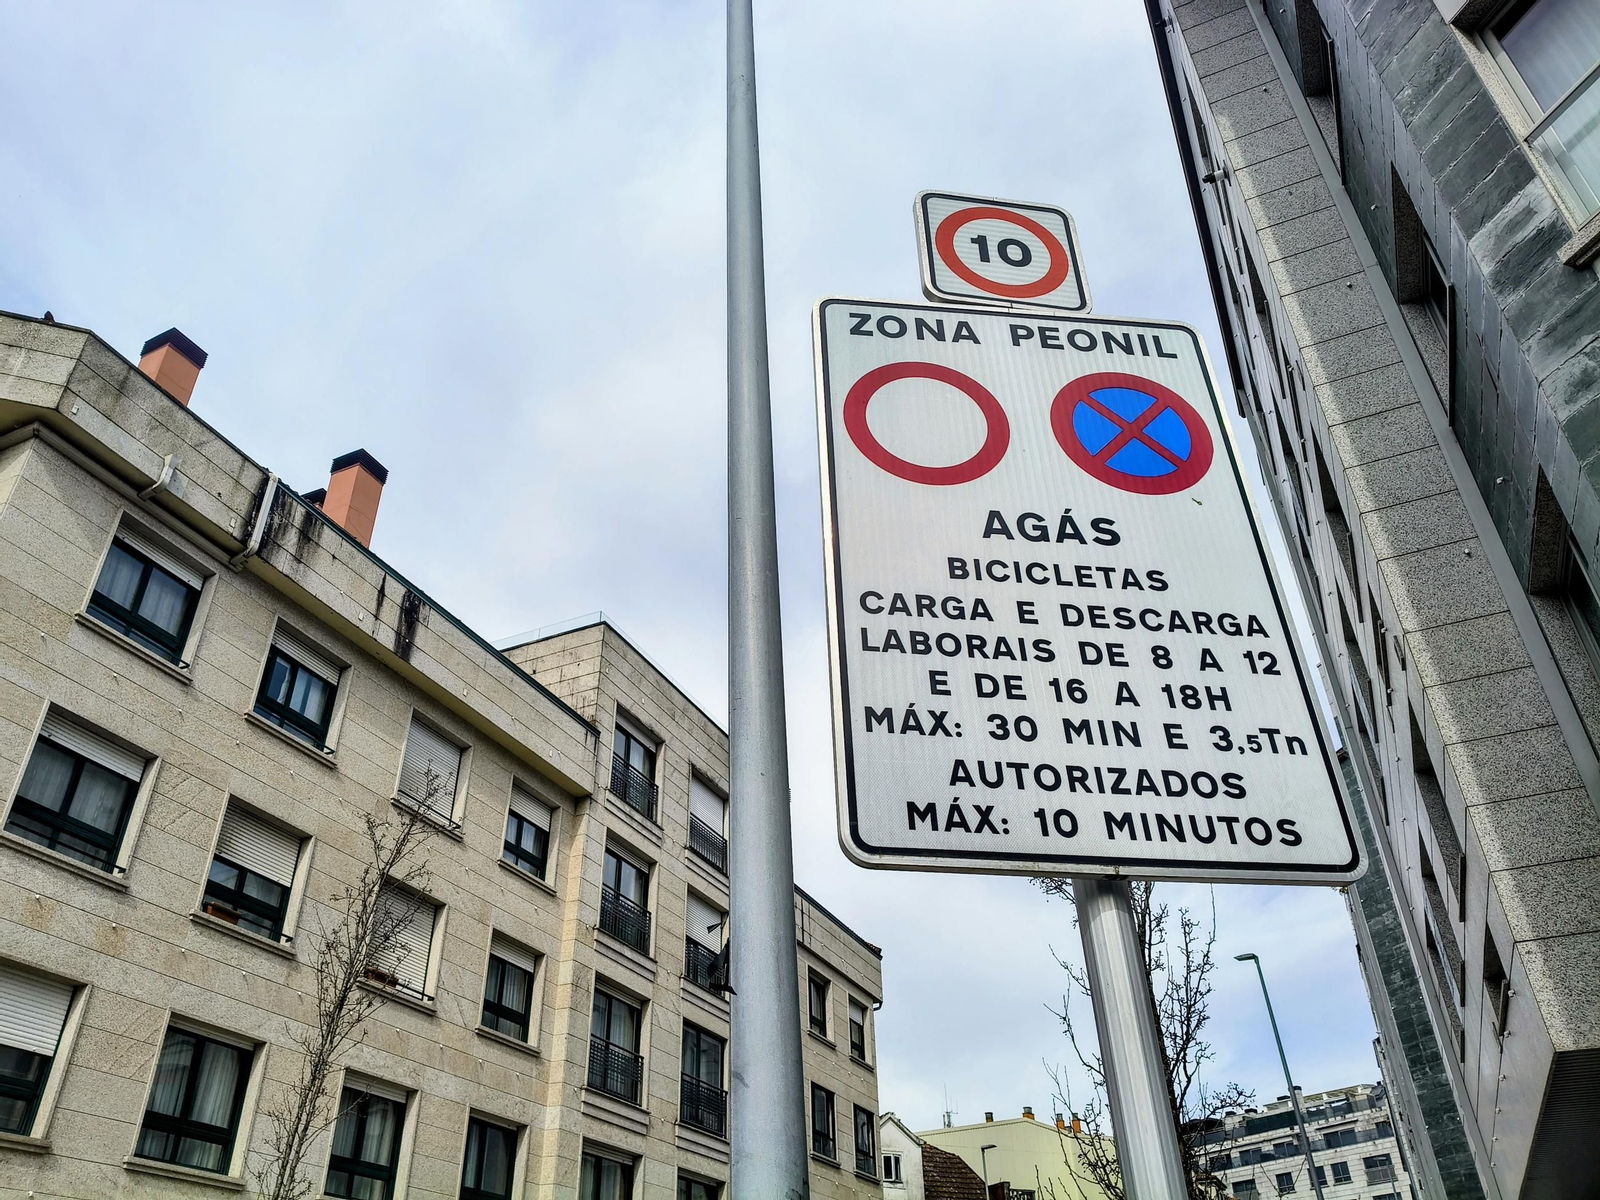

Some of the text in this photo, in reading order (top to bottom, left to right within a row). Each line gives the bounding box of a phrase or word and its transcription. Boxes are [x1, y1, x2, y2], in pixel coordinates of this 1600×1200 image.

[970, 234, 1034, 269] 10
[848, 312, 1178, 359] ZONA PEONIL
[982, 507, 1121, 547] AGÁS
[947, 556, 1169, 592] BICICLETAS
[859, 590, 1271, 639] CARGA E DESCARGA
[860, 627, 1282, 676] LABORAIS DE 8 A 12
[928, 669, 1233, 712] E DE 16 A 18H
[864, 702, 963, 738] MÁX:
[986, 713, 1039, 743] 30
[1061, 717, 1142, 748] MIN
[1162, 722, 1189, 750] E
[949, 758, 1247, 800] AUTORIZADOS
[906, 797, 1303, 847] MÁX: 10 MINUTOS
